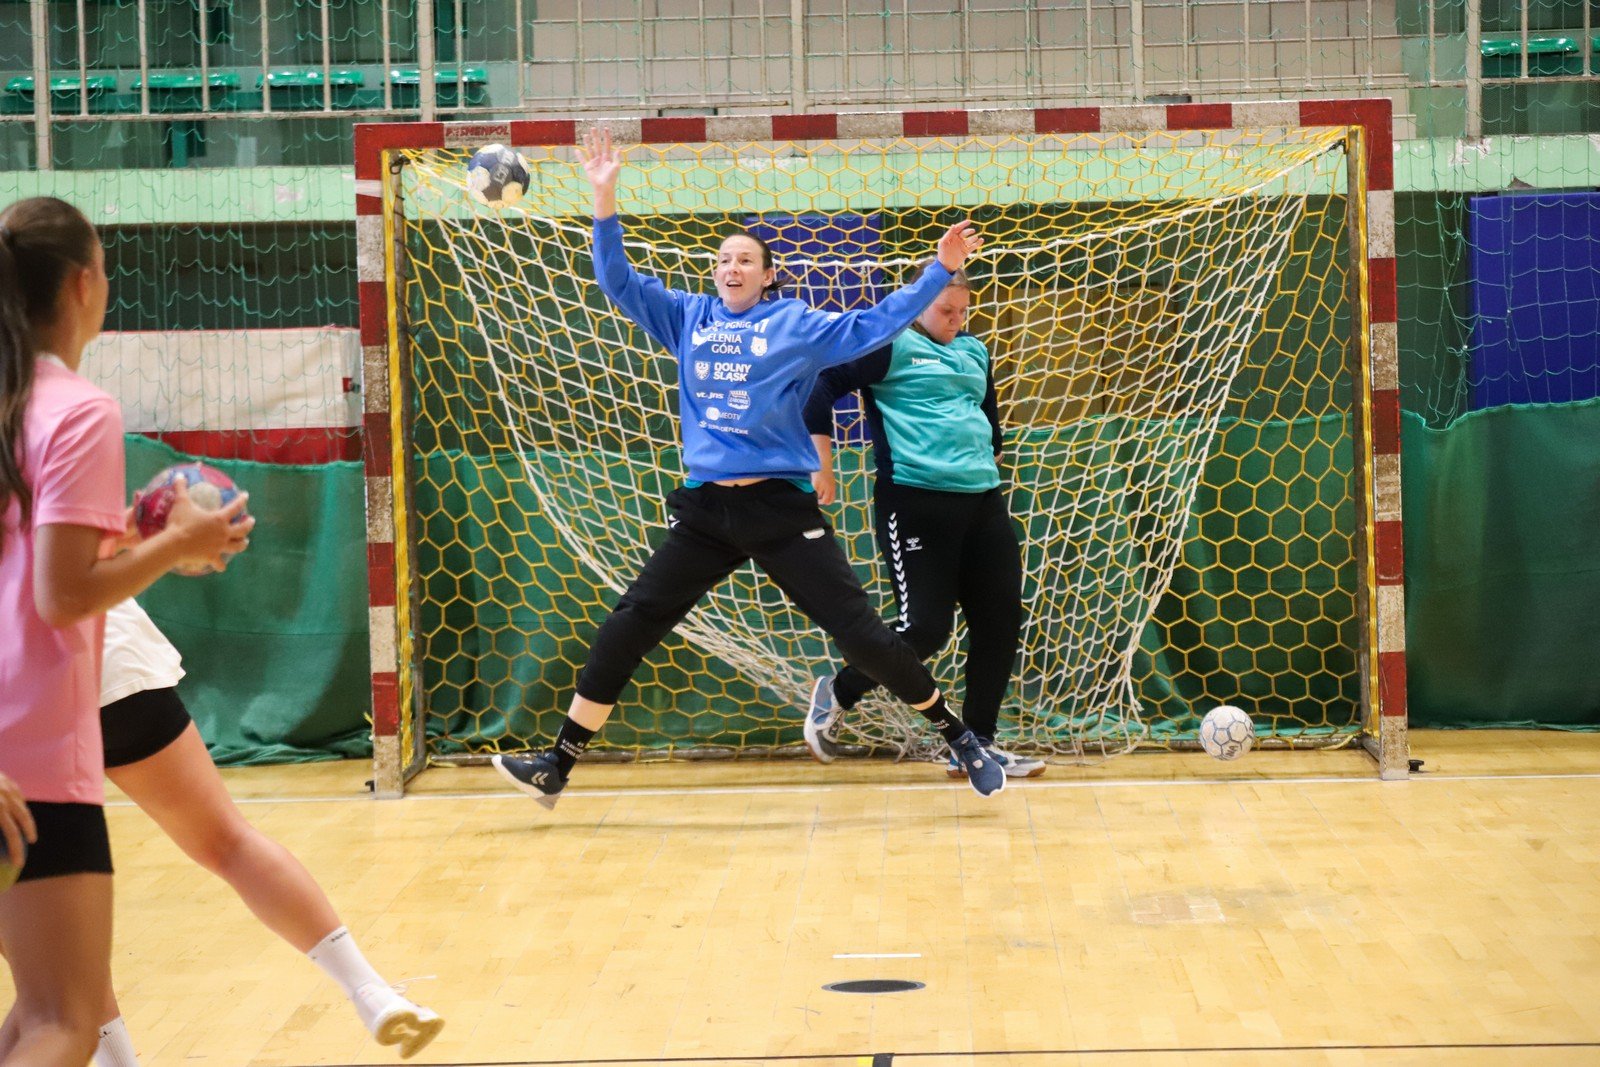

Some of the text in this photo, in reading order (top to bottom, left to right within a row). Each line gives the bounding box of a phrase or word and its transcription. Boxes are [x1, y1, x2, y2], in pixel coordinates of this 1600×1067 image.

[707, 333, 742, 343] ELENIA
[711, 343, 741, 354] GÓRA
[714, 362, 752, 373] DOLNY
